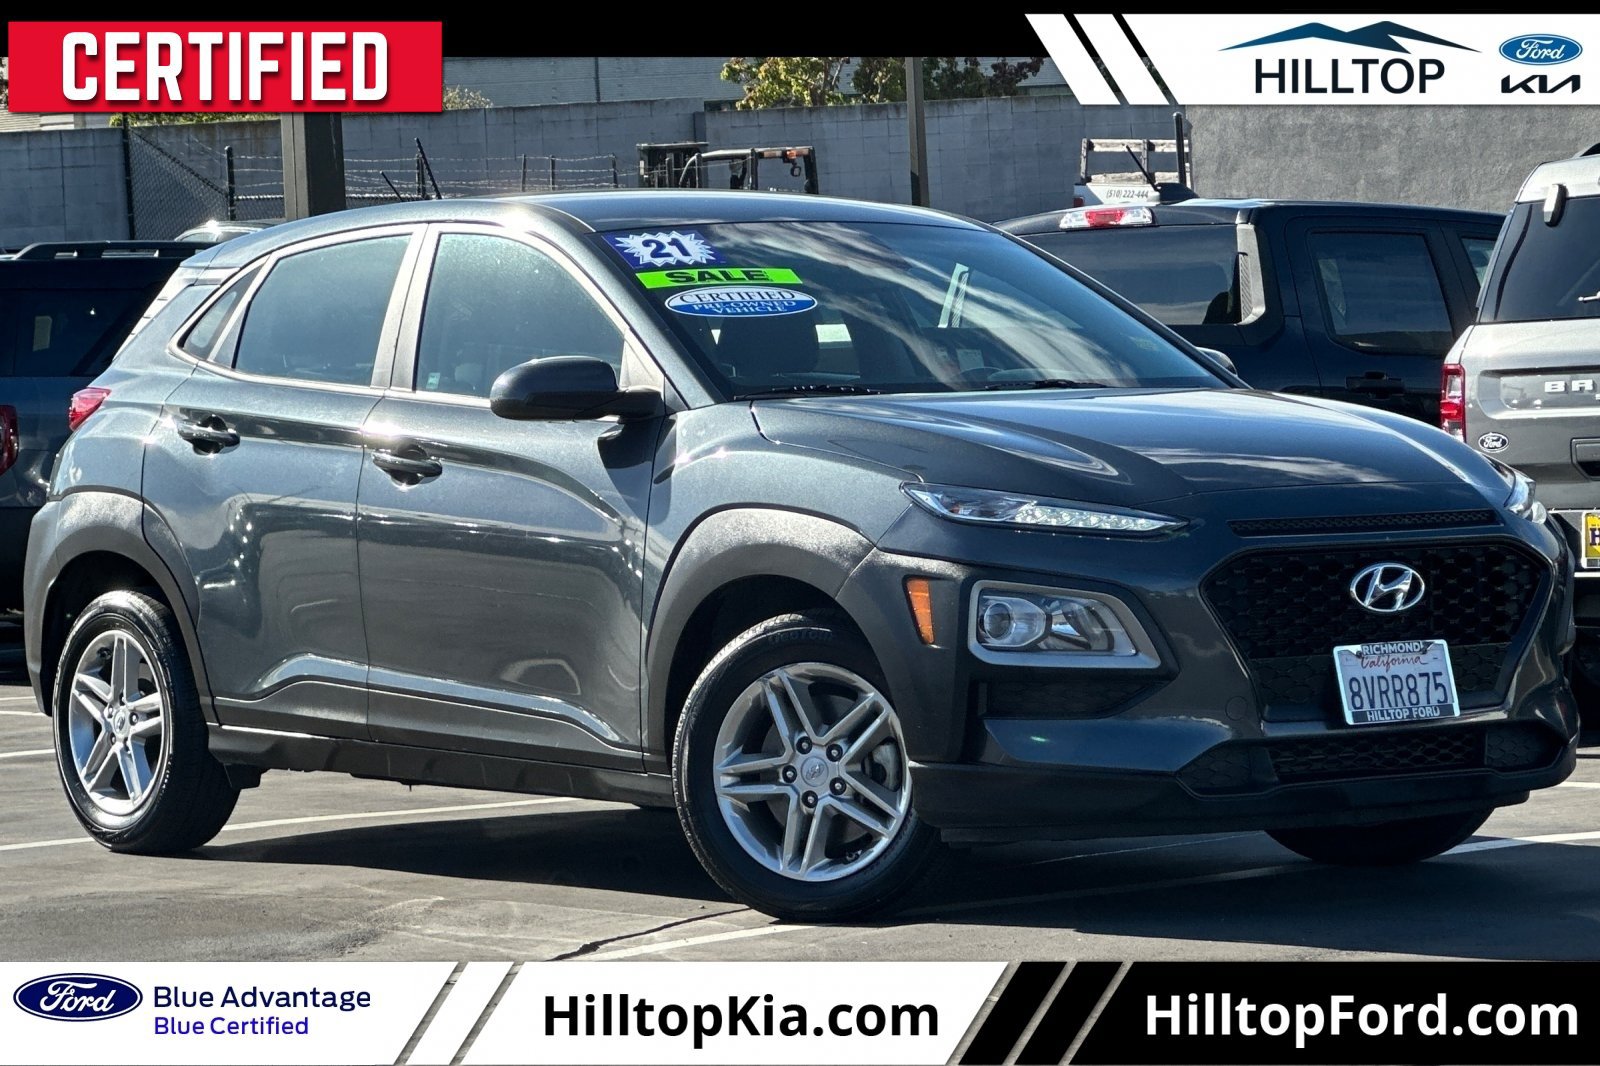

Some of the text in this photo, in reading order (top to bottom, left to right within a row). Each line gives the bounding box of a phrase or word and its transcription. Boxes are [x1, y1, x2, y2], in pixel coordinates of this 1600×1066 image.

[1106, 190, 1122, 199] (510)
[641, 238, 692, 258] 21
[665, 270, 771, 283] SALE
[679, 291, 796, 304] CERTIFIED
[691, 300, 797, 311] PRE-OWNED
[712, 305, 788, 314] VEHICLE
[1483, 434, 1504, 449] Ford
[1362, 642, 1420, 654] RICHMOND
[1361, 656, 1428, 672] California
[1349, 672, 1448, 710] 8VRR875
[1367, 706, 1440, 721] HILLTOP FORD
